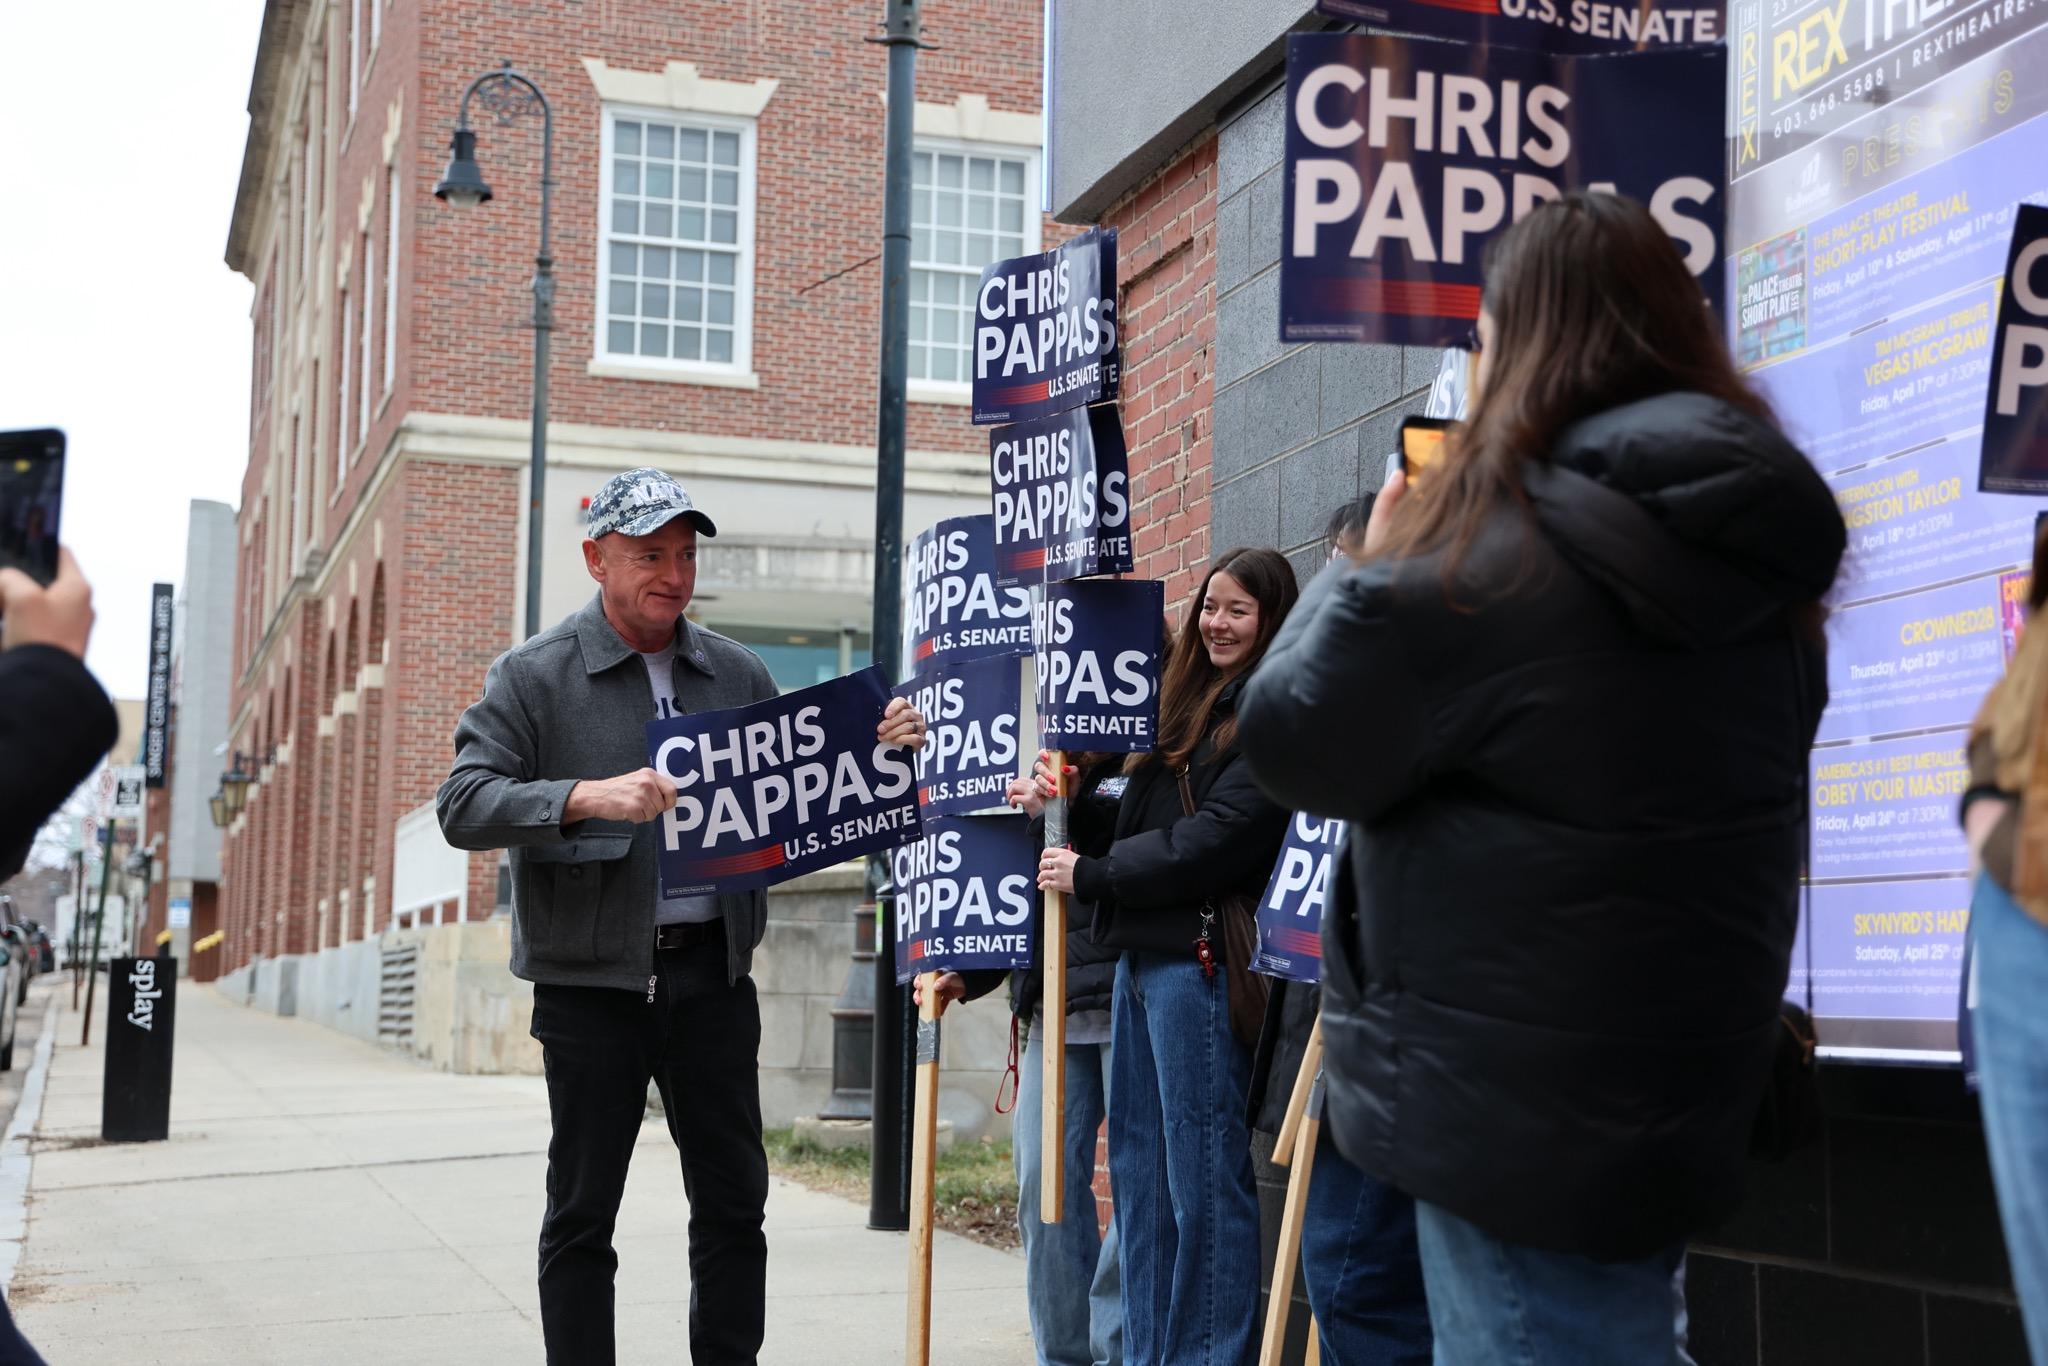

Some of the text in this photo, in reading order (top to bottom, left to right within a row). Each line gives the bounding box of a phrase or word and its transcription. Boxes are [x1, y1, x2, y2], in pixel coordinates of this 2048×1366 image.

[1501, 0, 1718, 43] U.S. SENATE
[1773, 0, 1849, 101] REX
[1774, 67, 1885, 139] 603.668.5588
[1912, 0, 2048, 68] REXTHEATRE.
[1295, 64, 1571, 168] CHRIS
[1842, 70, 2015, 187] PRESTS
[1293, 159, 1717, 278] PAPS
[1813, 232, 1829, 250] THE
[1832, 212, 1871, 241] PALACE
[1873, 191, 1918, 223] THEATRE
[1813, 221, 1896, 277] SHORT-PLAY
[1902, 191, 1969, 239] FESTIVAL
[1844, 266, 1865, 288] April
[1895, 236, 1944, 265] Saturday,
[1947, 221, 1973, 245] April
[980, 259, 1070, 321] CHRIS
[1742, 300, 1769, 329] SHORT
[1769, 291, 1792, 319] PLAY
[977, 297, 1100, 379] PAPPAS
[1864, 351, 1910, 388] VEGAS
[1912, 322, 1989, 370] MCGRAW
[1048, 379, 1066, 398] U.S.
[1066, 362, 1100, 392] SENATE
[1892, 381, 1915, 405] April
[993, 428, 1070, 487] CHRIS
[994, 470, 1098, 545] PAPPAS
[1836, 477, 1894, 506] FTERNOON
[1843, 475, 1963, 529] NGSTON TAYLOR
[914, 530, 969, 588] HRIS
[1045, 536, 1096, 566] U.S. SENATE
[1098, 536, 1129, 558] ATE
[1862, 531, 1885, 552] April
[911, 573, 1031, 641] APPAS
[1030, 598, 1074, 646] HRIS
[932, 625, 1030, 653] U.S. SENATE
[1850, 660, 1897, 680] Thursday,
[1900, 653, 1924, 674] April
[908, 678, 964, 724] RIS
[1034, 650, 1150, 707] PPAS
[655, 705, 826, 790] CHRIS
[913, 713, 1017, 782] PPAS
[1065, 714, 1148, 736] SENATE
[928, 772, 1015, 803] U.S. SENATE
[1889, 754, 1912, 773] BEST
[1915, 748, 1969, 769] METALLIC
[663, 740, 912, 851] PAPPAS
[1816, 782, 1858, 808] OBEY
[1862, 776, 1904, 802] YOUR
[784, 804, 917, 860] U.S. SENATE
[1816, 815, 1850, 833] Friday,
[1852, 811, 1876, 830] April
[894, 830, 962, 888] CHRIS
[896, 874, 1030, 943] PAPPAS
[1854, 908, 1970, 937] SKYNYRD'S HAT
[923, 934, 1027, 957] U.S. SENATE
[1855, 945, 1901, 964] Saturday,
[1904, 944, 1928, 963] April
[127, 959, 163, 1032] splay
